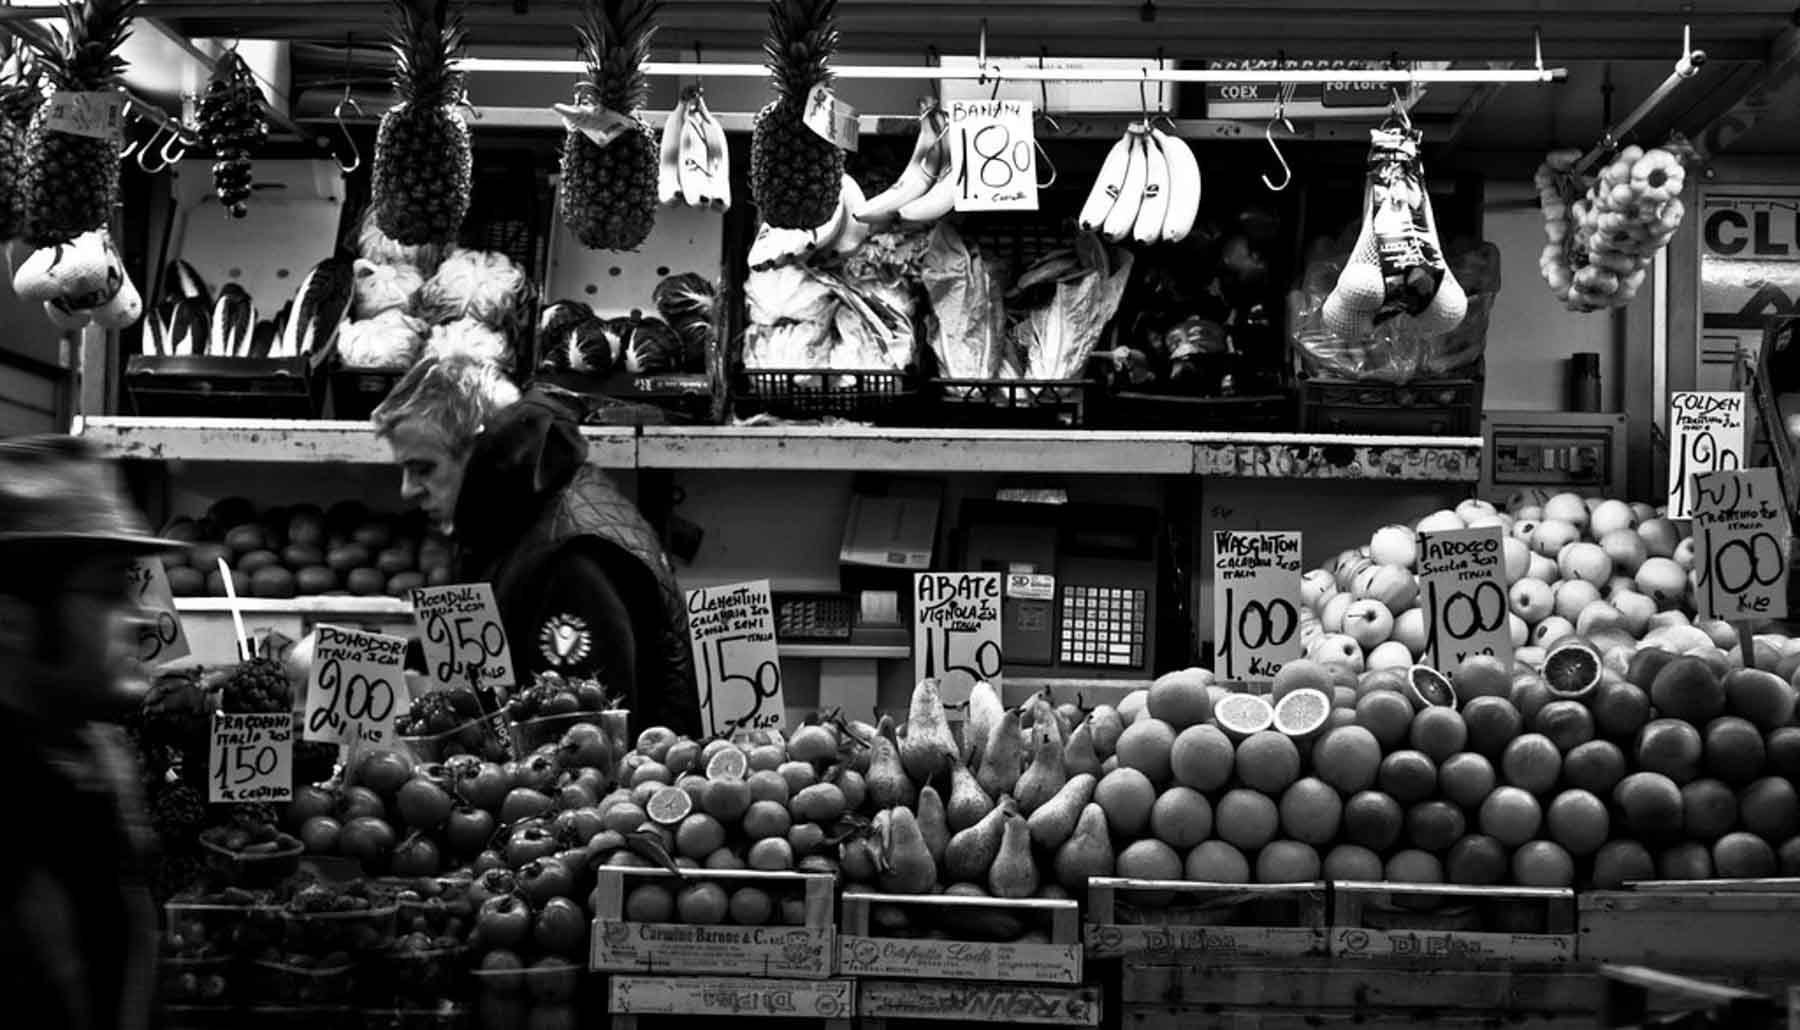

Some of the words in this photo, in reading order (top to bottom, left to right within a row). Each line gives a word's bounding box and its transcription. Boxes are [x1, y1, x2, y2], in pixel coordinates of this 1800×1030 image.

[1220, 85, 1258, 99] COEX
[1704, 209, 1800, 255] CL
[1672, 393, 1740, 425] GOLDEN
[919, 574, 1000, 611] ABATE
[318, 628, 408, 656] POMODORI
